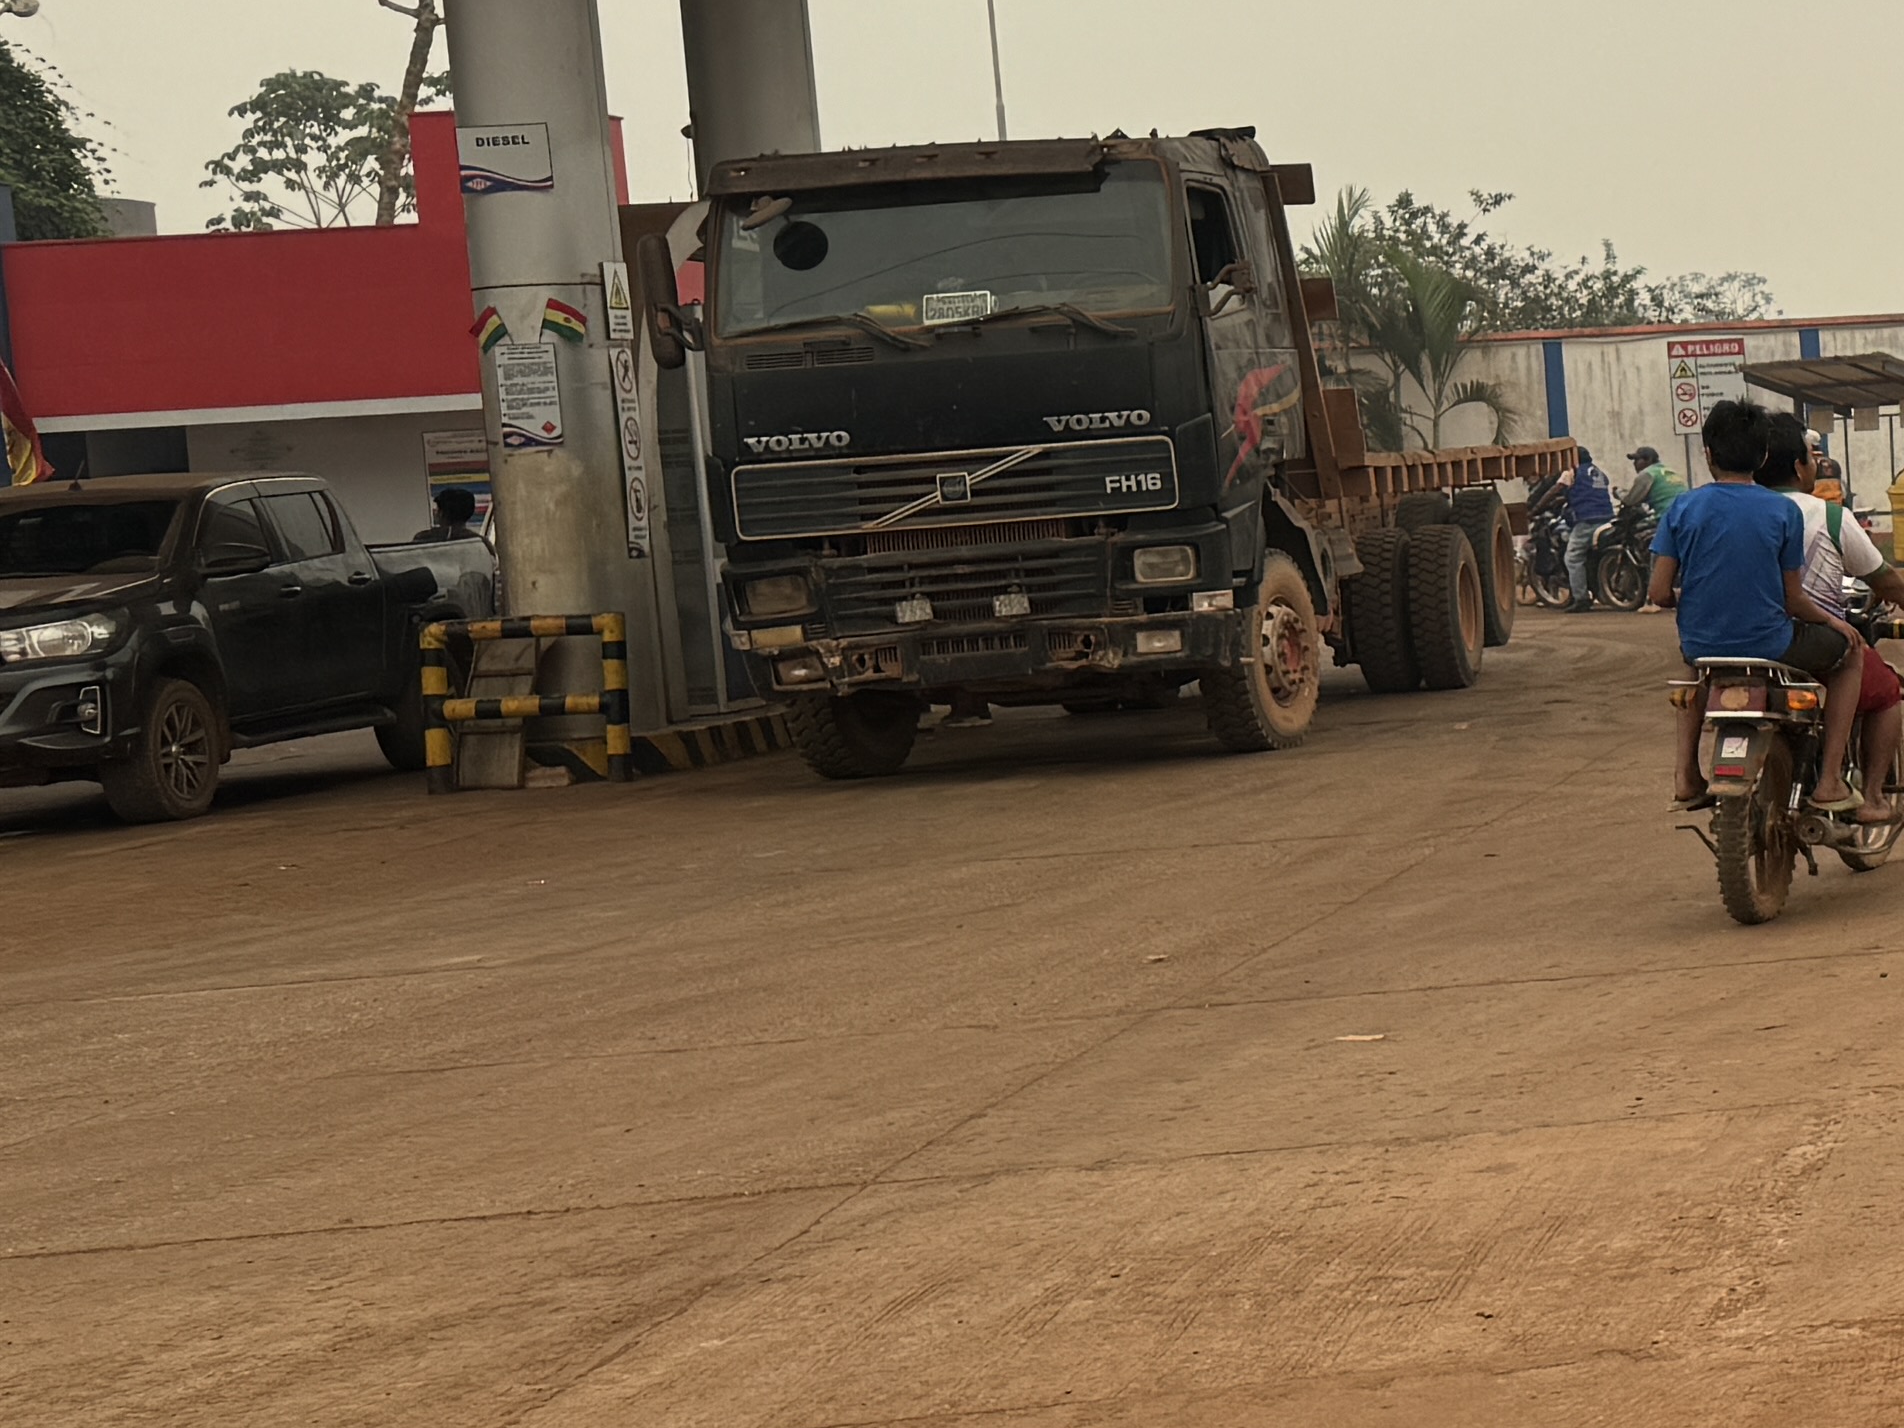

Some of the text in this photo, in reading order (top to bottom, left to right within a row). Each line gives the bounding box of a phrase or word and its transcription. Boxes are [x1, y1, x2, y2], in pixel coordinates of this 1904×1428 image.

[475, 134, 530, 147] DIESEL
[1687, 342, 1739, 355] PELIGRO
[1043, 409, 1151, 432] VOLVO
[744, 430, 851, 453] VOLVO
[1105, 472, 1162, 494] FH16
